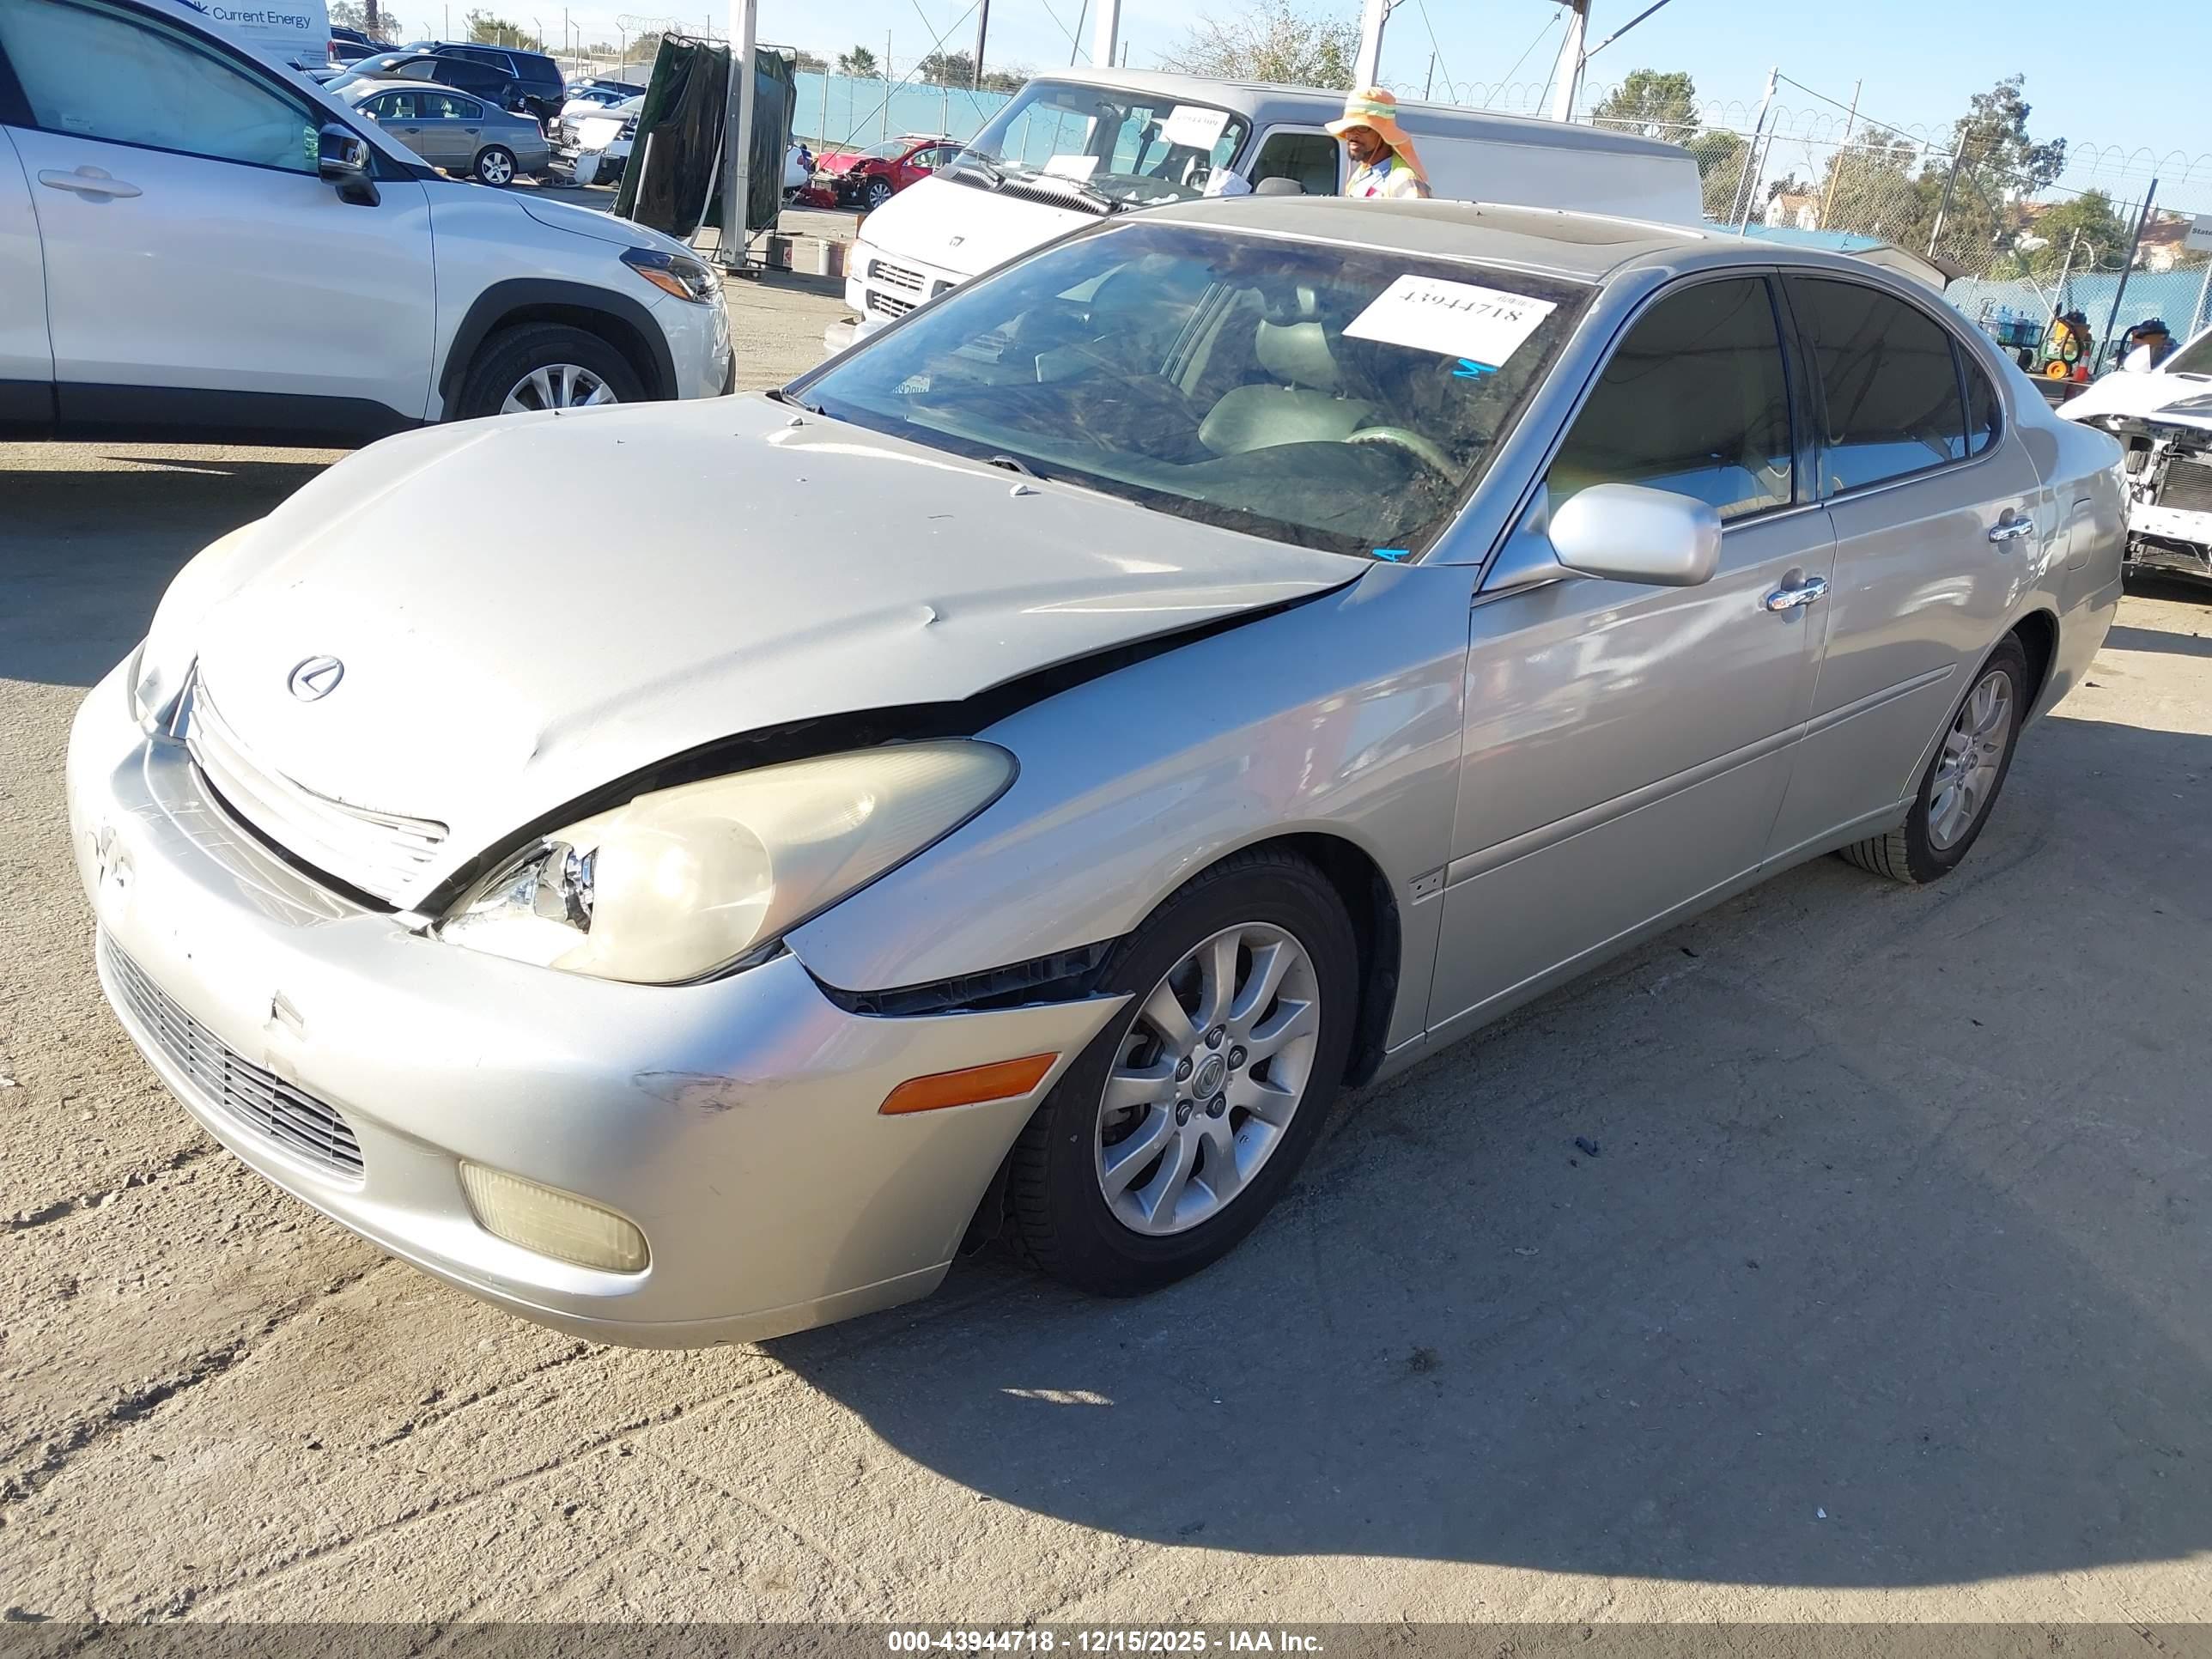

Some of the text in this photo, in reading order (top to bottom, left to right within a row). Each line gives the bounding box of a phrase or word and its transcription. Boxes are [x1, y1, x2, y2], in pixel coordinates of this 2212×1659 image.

[213, 7, 311, 29] Current Energy
[1400, 290, 1523, 322] 43944718
